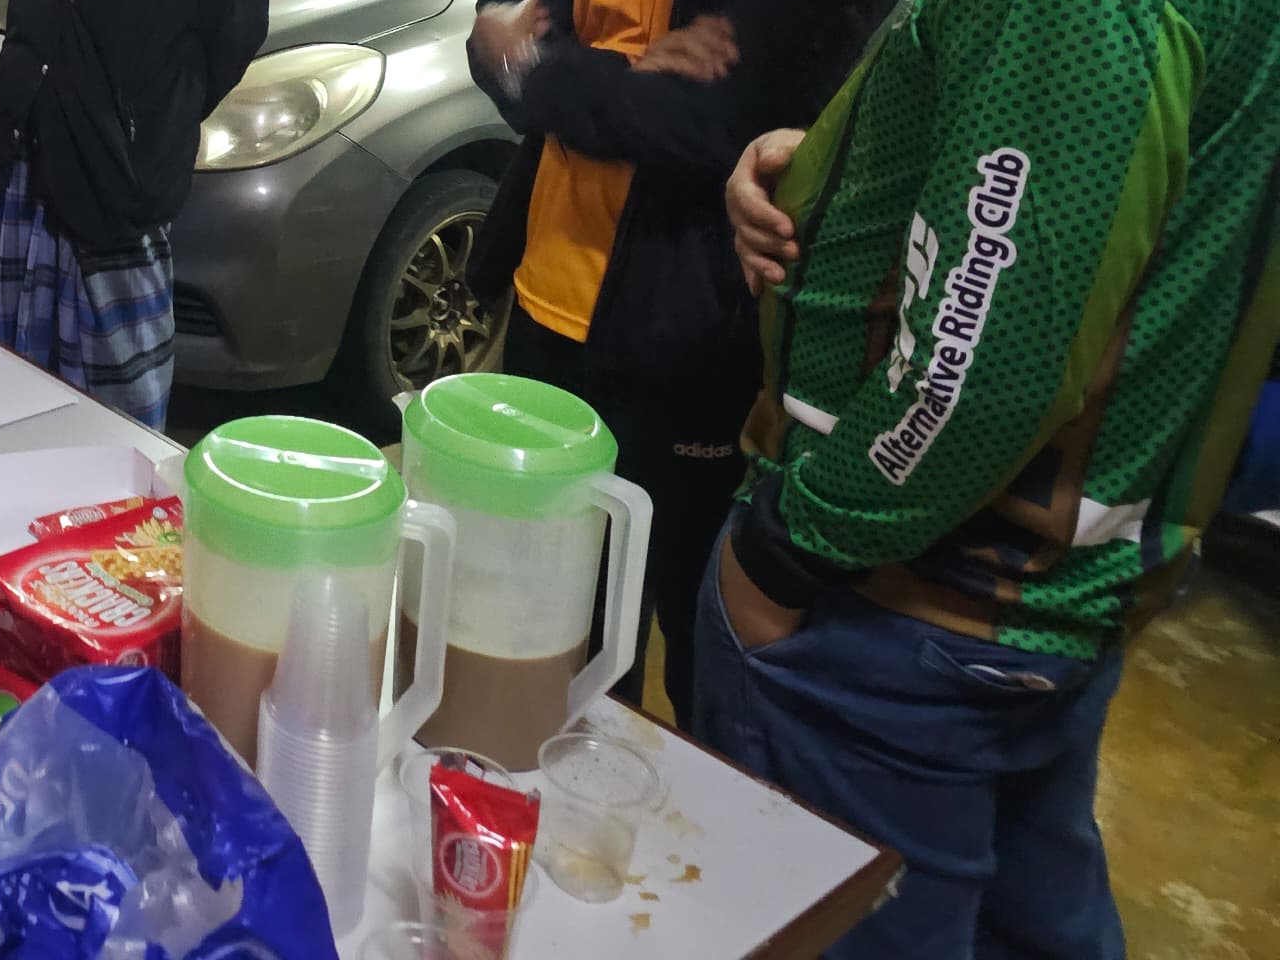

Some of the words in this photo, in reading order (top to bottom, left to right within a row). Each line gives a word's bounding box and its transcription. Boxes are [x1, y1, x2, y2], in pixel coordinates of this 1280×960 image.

[874, 346, 967, 480] Alternative
[939, 234, 1009, 341] Riding
[975, 154, 1024, 228] Club
[673, 443, 732, 458] adidas
